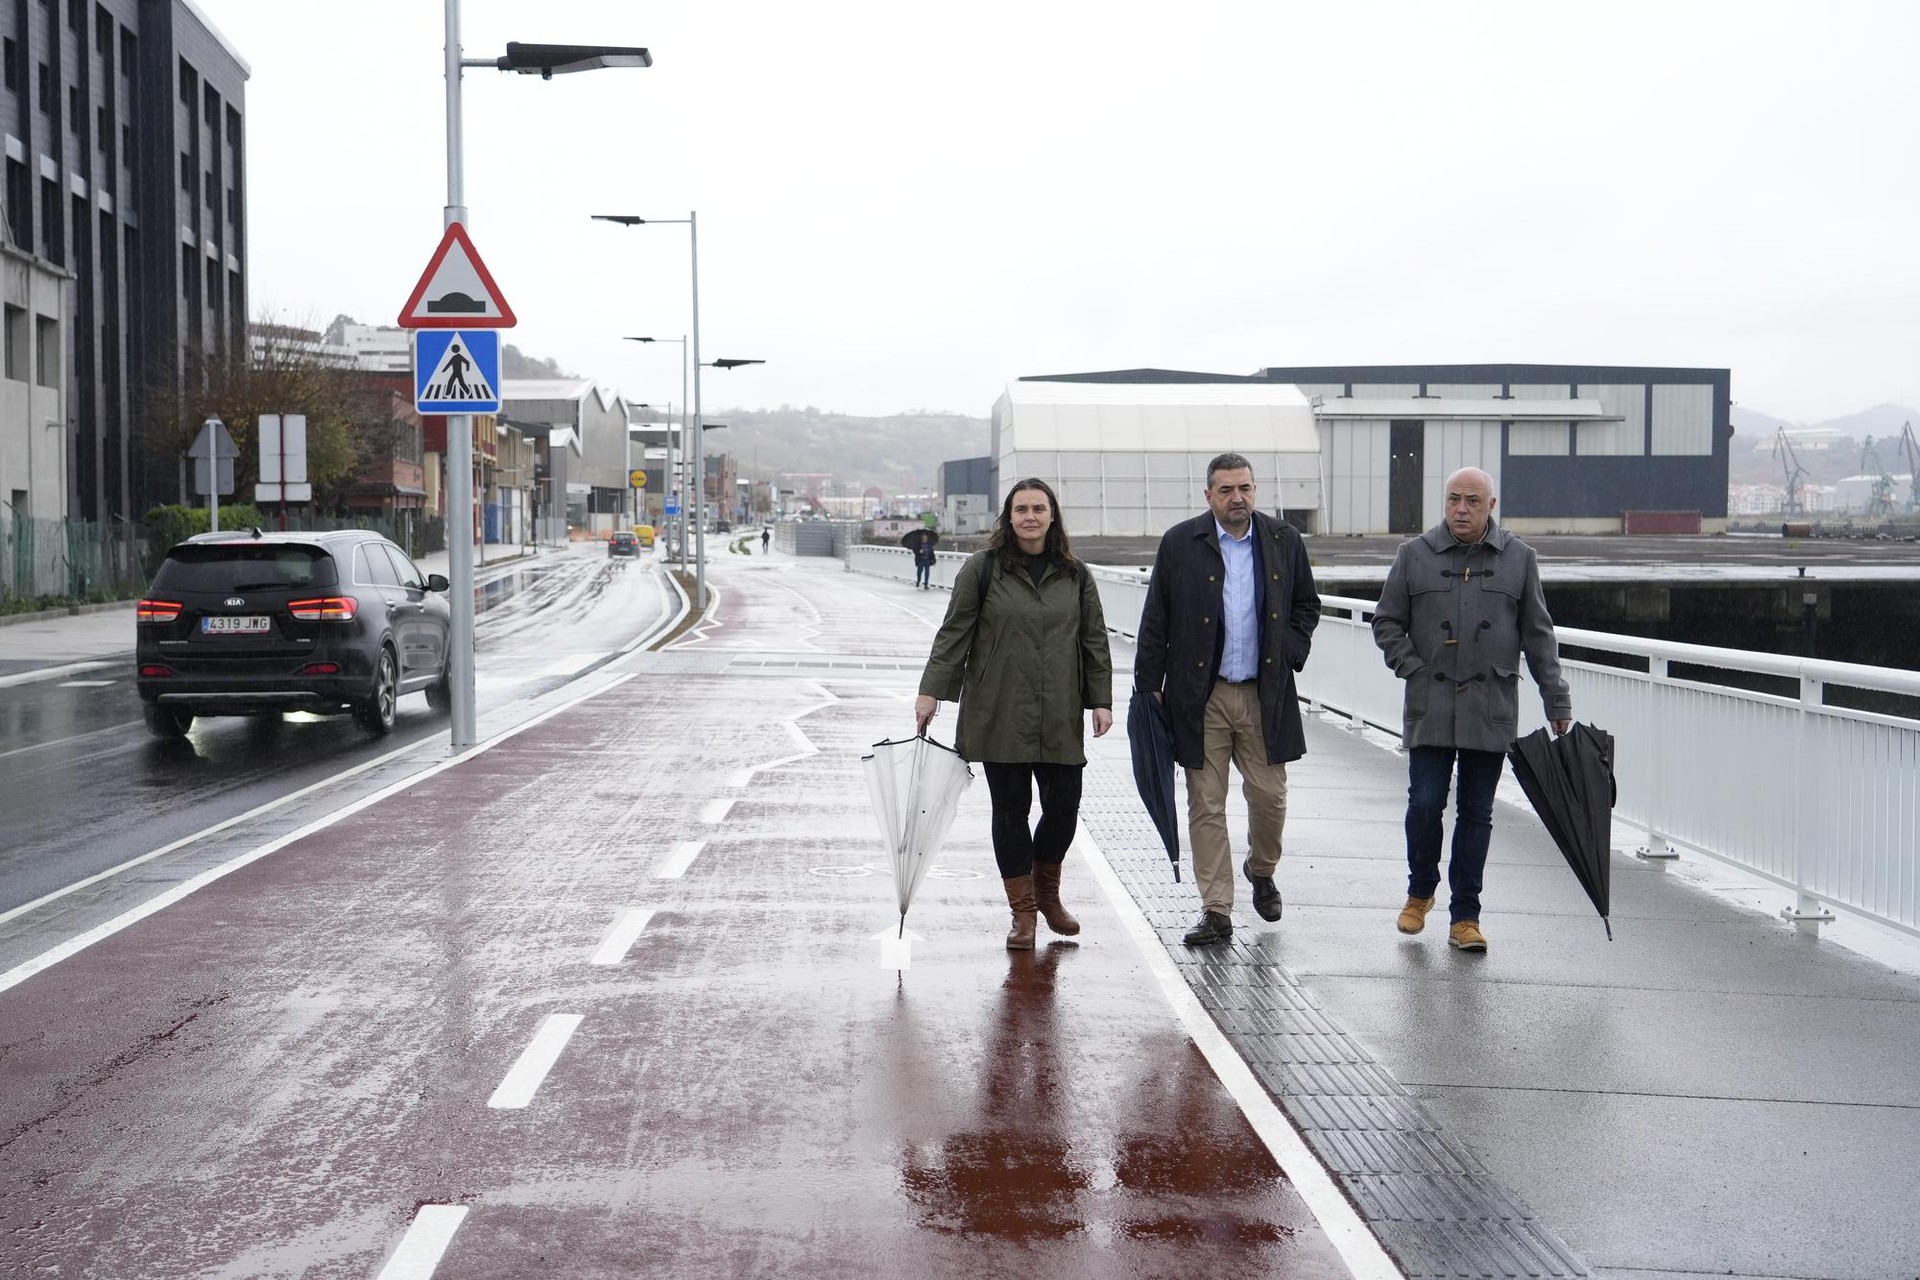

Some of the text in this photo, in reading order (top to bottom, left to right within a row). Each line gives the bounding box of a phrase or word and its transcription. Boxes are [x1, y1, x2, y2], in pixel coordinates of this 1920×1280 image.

[227, 598, 241, 606] KIA
[209, 618, 267, 629] 4319 JWG
